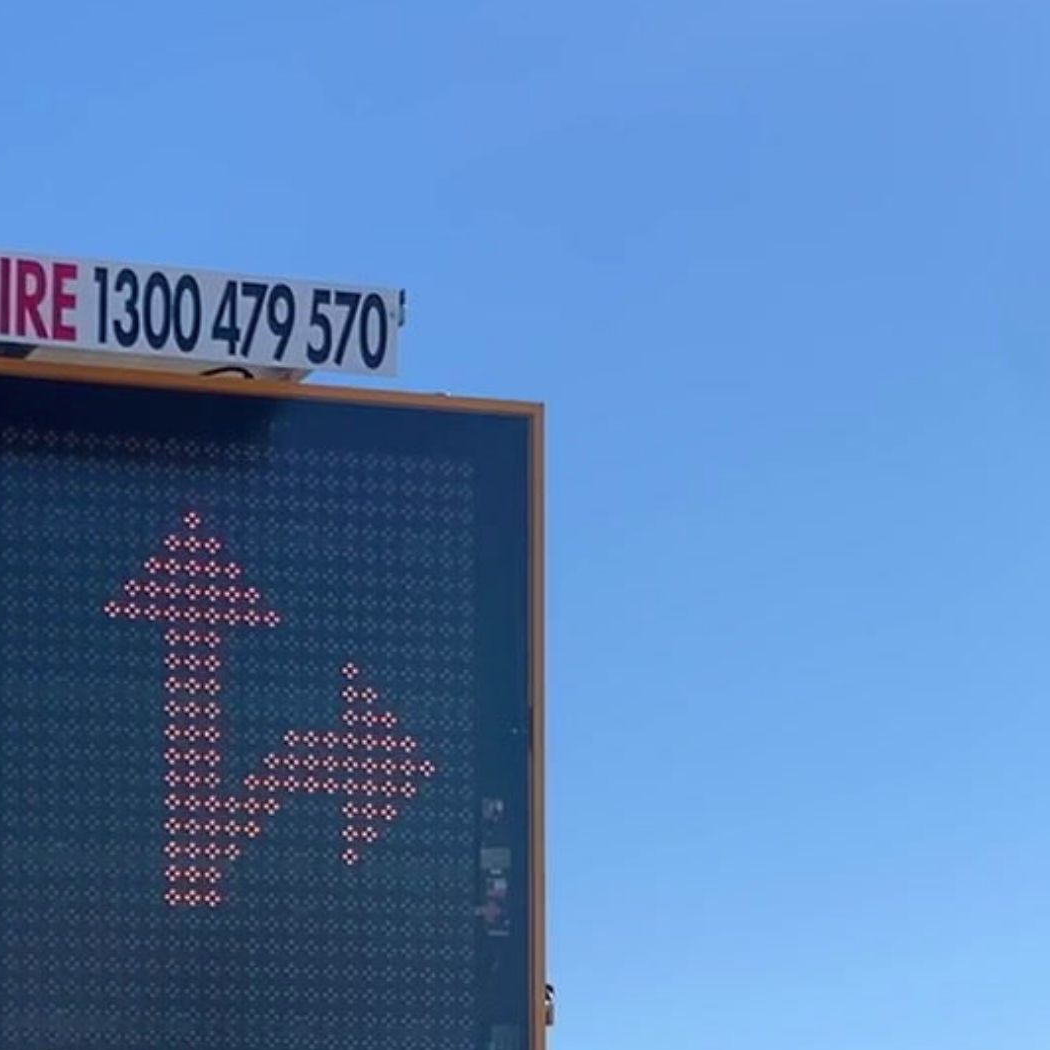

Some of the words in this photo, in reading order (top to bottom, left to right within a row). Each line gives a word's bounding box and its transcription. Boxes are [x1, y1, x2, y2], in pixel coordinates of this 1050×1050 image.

[94, 266, 202, 353] 1300
[211, 280, 295, 361] 479
[306, 289, 388, 370] 570
